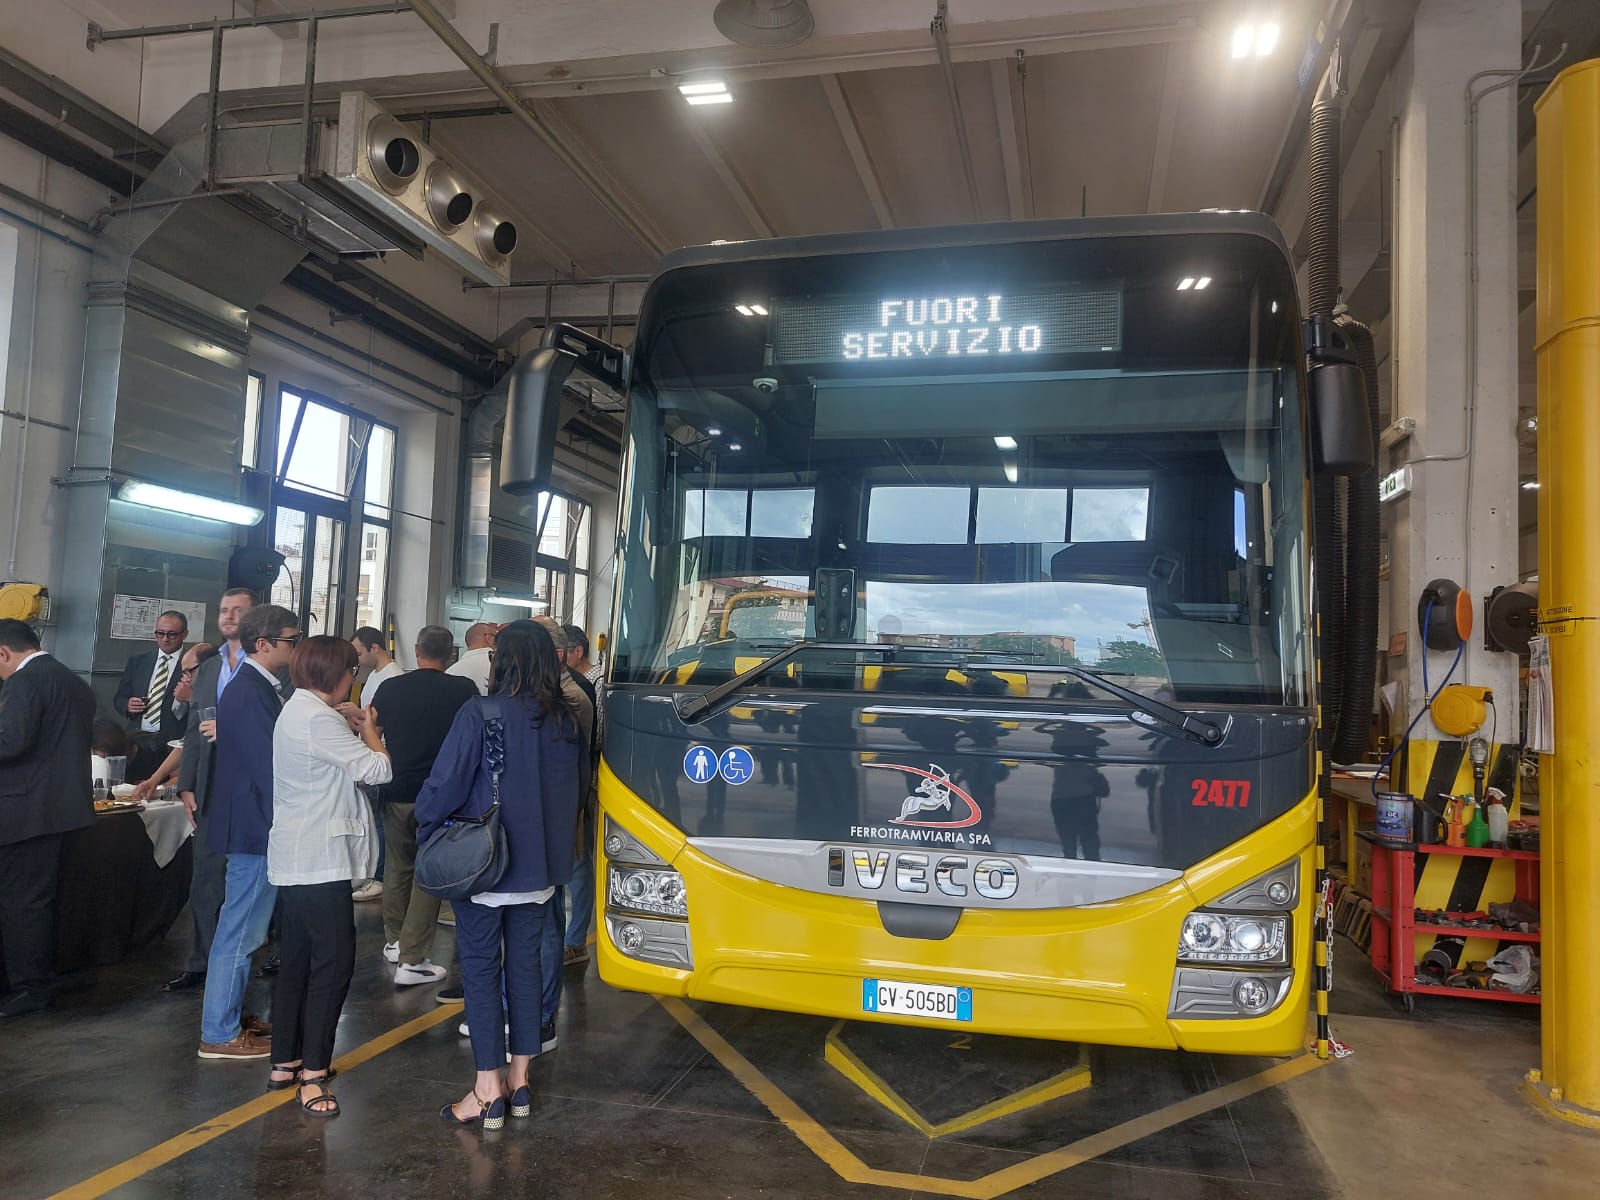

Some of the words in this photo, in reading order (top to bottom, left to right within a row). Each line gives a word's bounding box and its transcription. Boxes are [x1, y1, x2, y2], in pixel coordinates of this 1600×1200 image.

[880, 295, 1002, 327] FUORI
[842, 325, 1042, 360] SERVIZIO
[1191, 778, 1251, 808] 2477
[850, 825, 965, 844] FERROTRAMVIARIA
[828, 848, 1020, 900] IVECO
[878, 986, 897, 1007] GV
[905, 989, 957, 1014] 505BD
